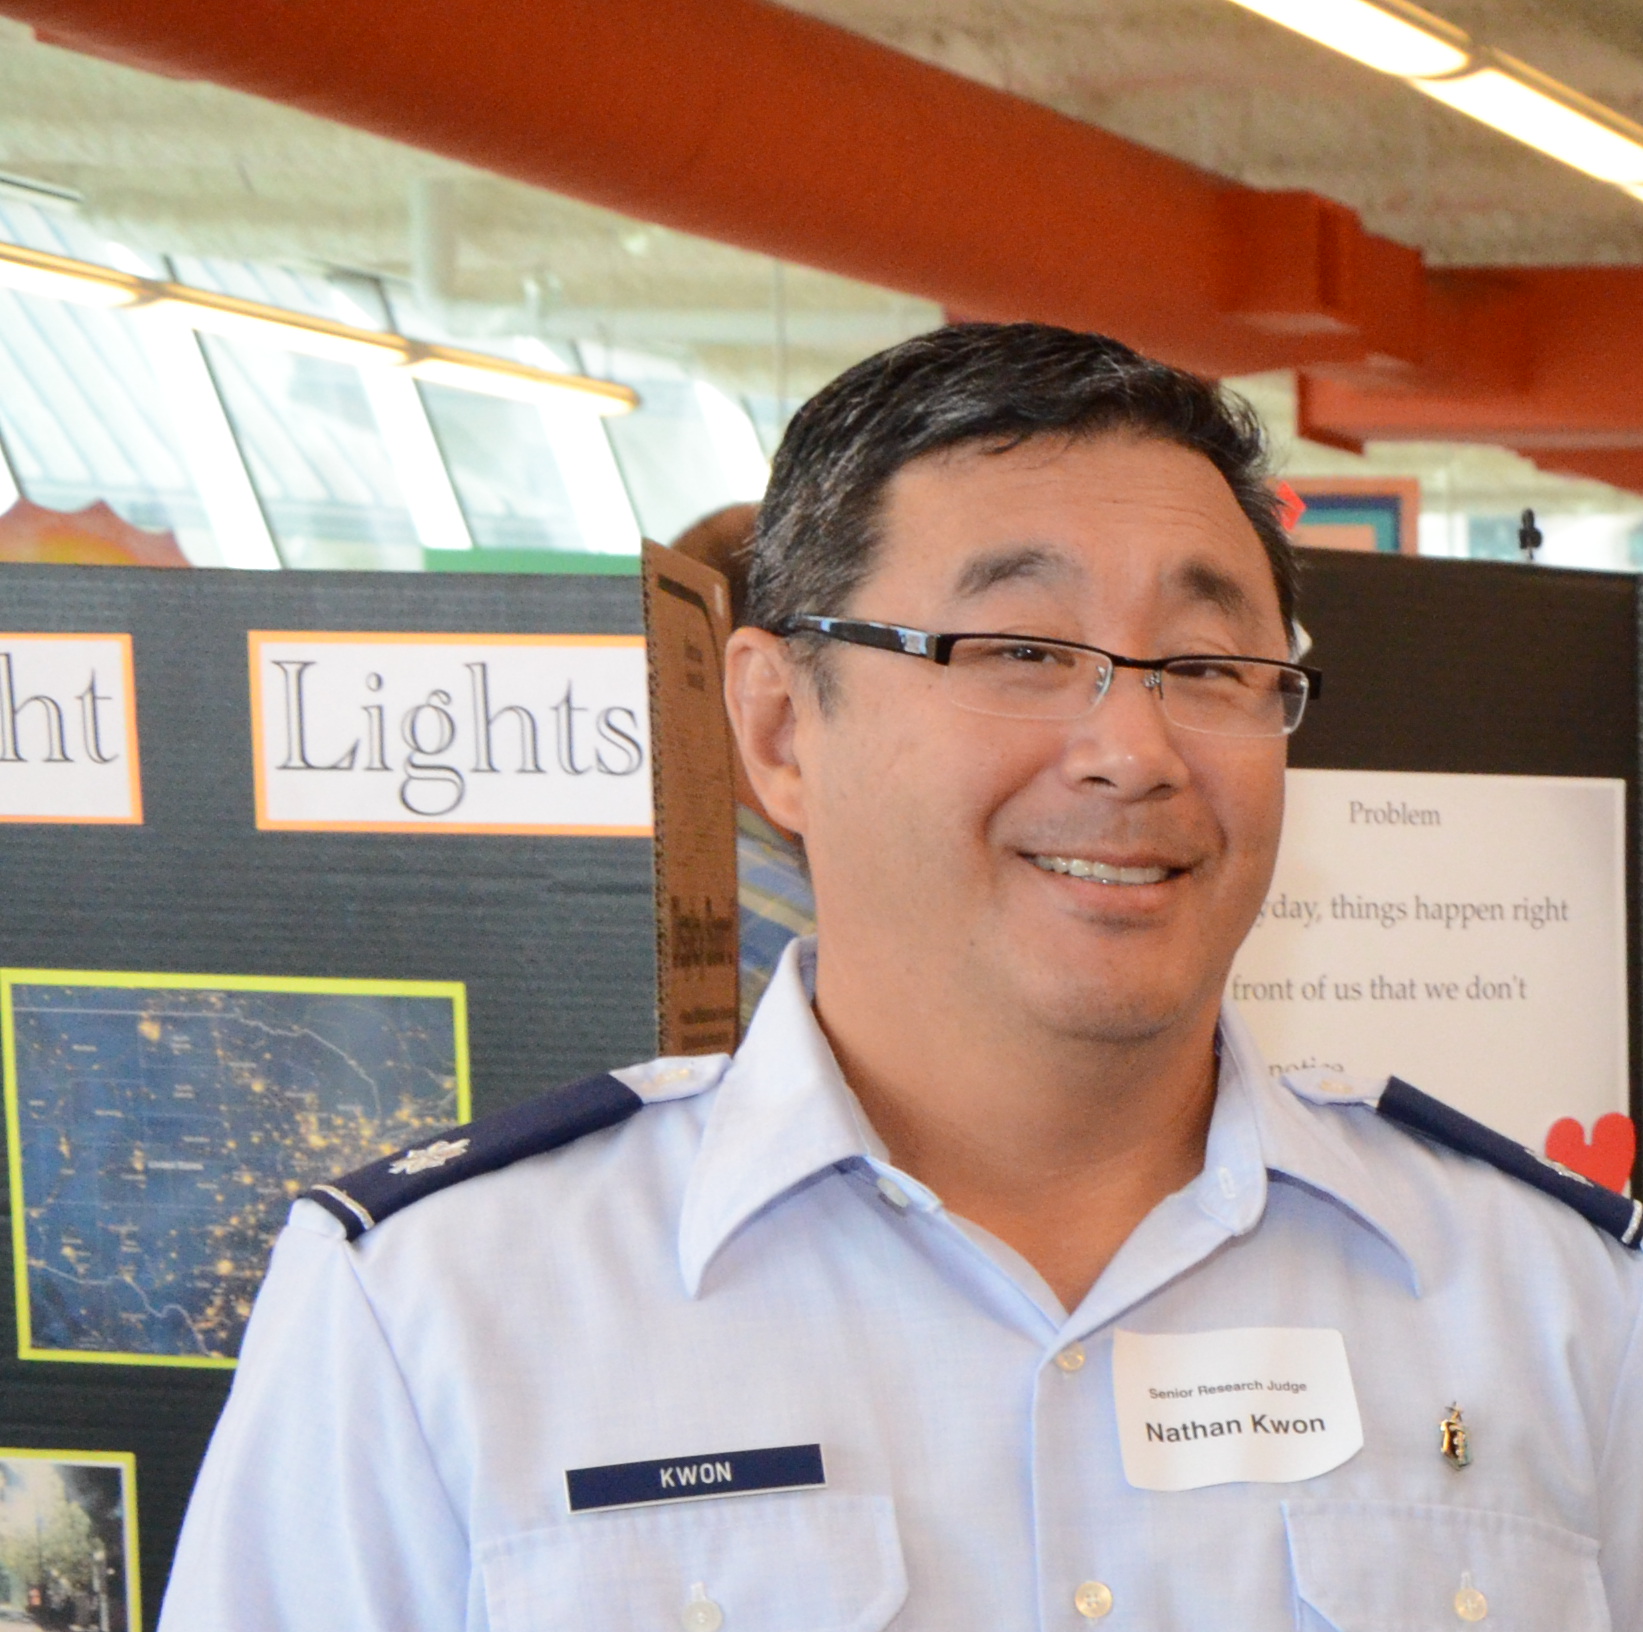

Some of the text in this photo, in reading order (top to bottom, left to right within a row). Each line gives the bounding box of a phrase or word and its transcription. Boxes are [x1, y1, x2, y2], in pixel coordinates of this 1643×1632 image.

[270, 660, 644, 815] Lights
[1349, 800, 1441, 826] Problem
[1263, 893, 1569, 930] yday, things happen right
[1232, 974, 1527, 1002] front of us that we don't
[1148, 1380, 1308, 1400] Senior Research Judge
[1145, 1413, 1326, 1443] Nathan Kwon
[660, 1460, 733, 1489] KWON
